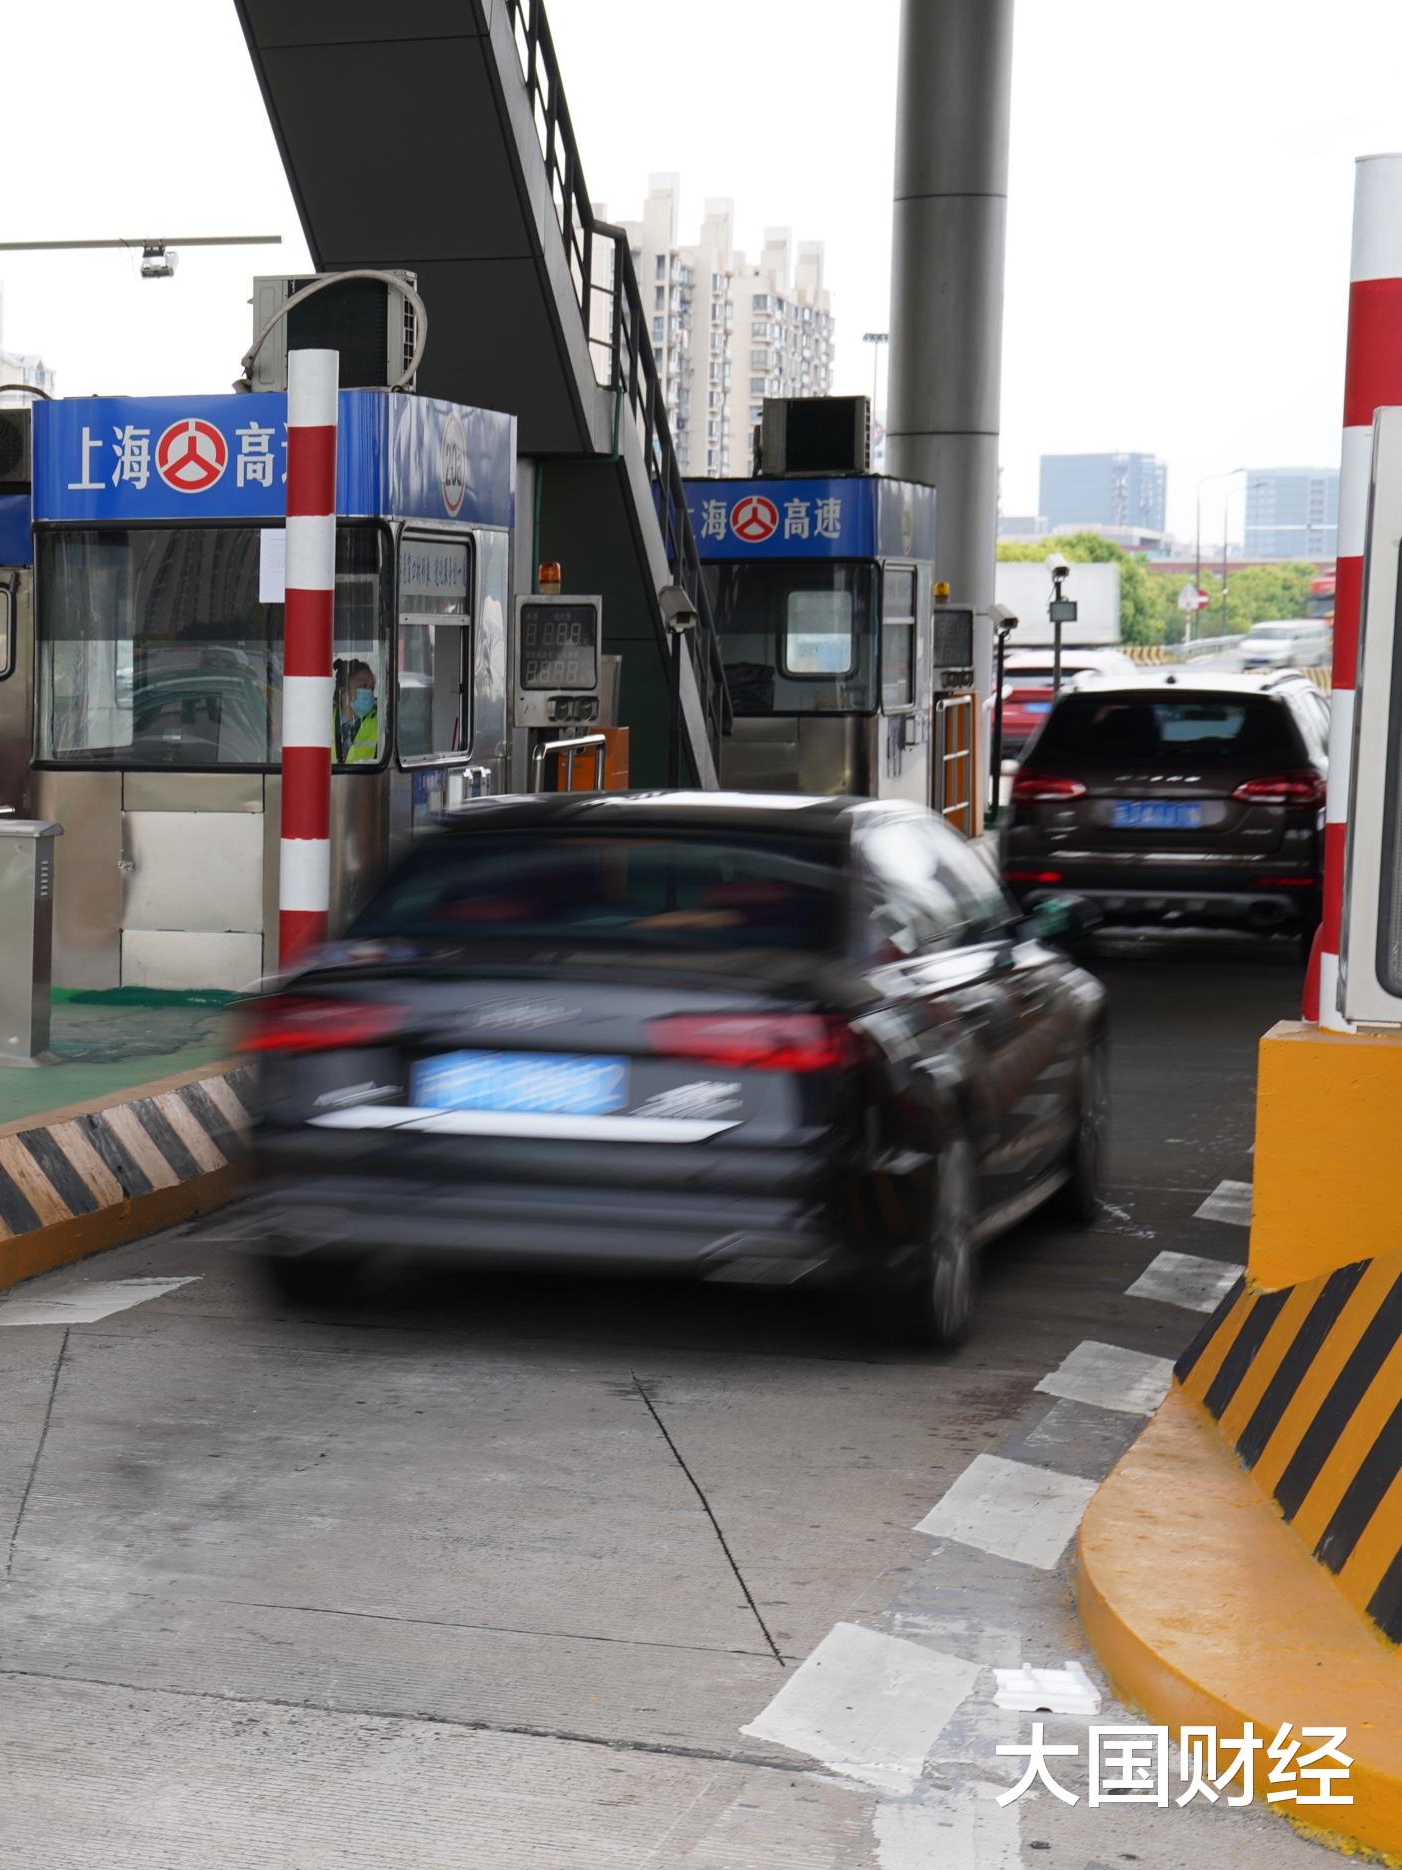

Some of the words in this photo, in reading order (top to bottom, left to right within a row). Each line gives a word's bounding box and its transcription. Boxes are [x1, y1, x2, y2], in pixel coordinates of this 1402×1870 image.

[67, 424, 151, 490] 上海
[234, 420, 288, 488] 高
[687, 498, 728, 541] 海
[783, 497, 843, 541] 高速
